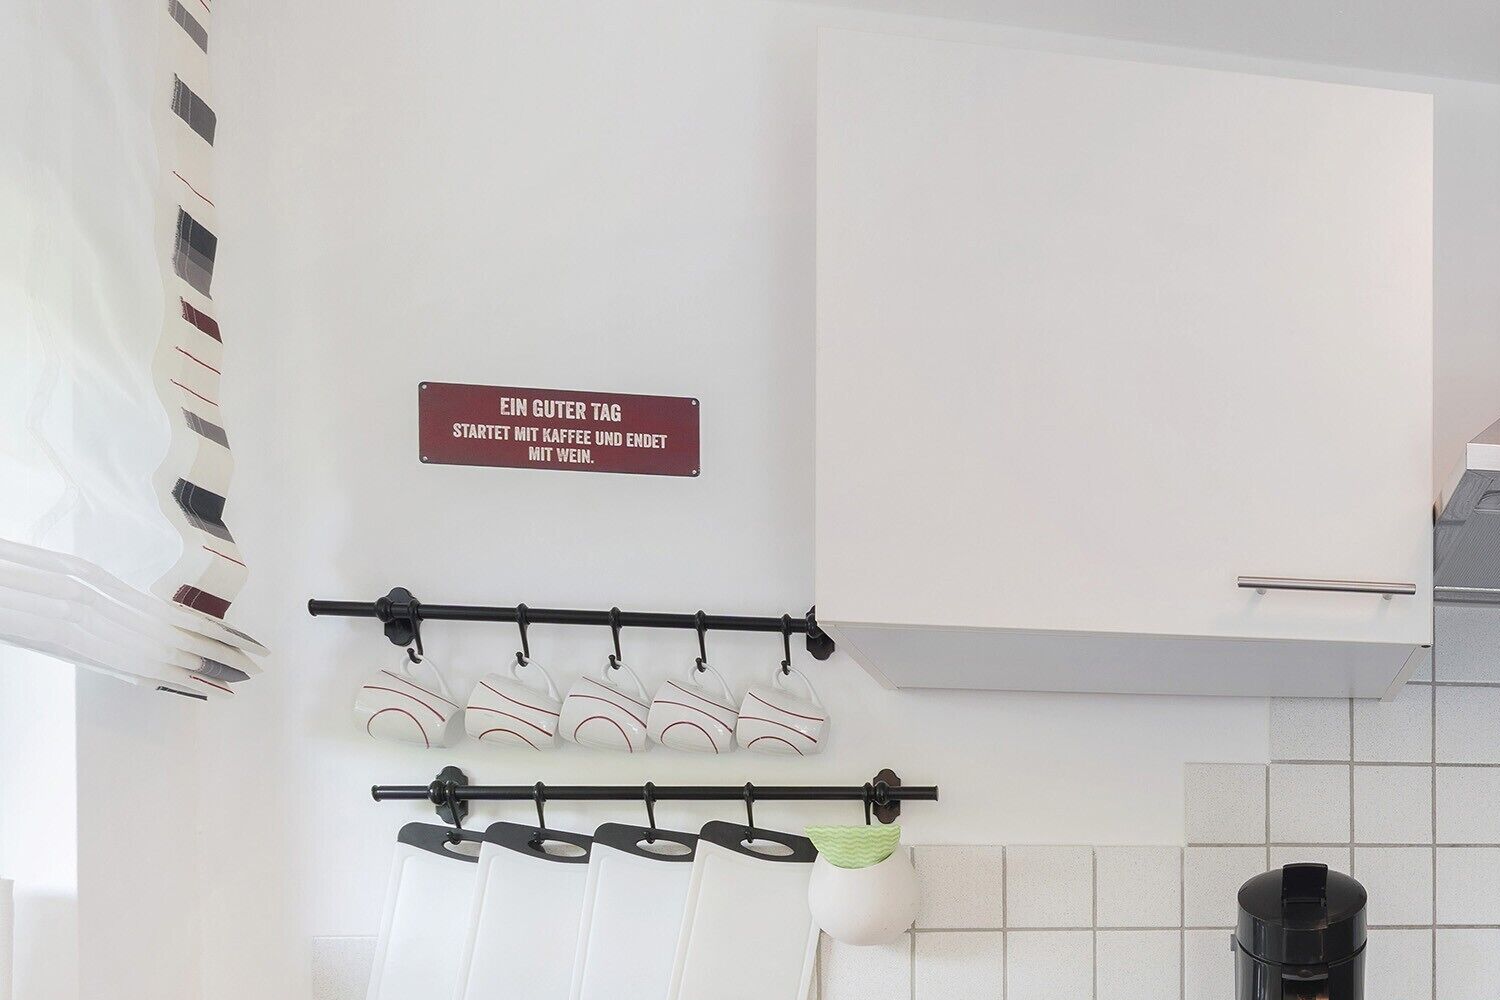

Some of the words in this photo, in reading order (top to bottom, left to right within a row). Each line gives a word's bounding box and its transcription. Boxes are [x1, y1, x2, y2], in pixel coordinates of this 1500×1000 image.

[500, 397, 527, 416] EIN
[532, 400, 586, 420] GUTER
[591, 403, 622, 422] TAG
[453, 422, 511, 440] STARTET
[514, 426, 539, 442] MIT
[543, 428, 591, 445] KAFFEE
[595, 431, 623, 447] UND
[626, 433, 667, 449] ENDET
[529, 446, 553, 462] MIT
[556, 447, 594, 464] WEIN.
